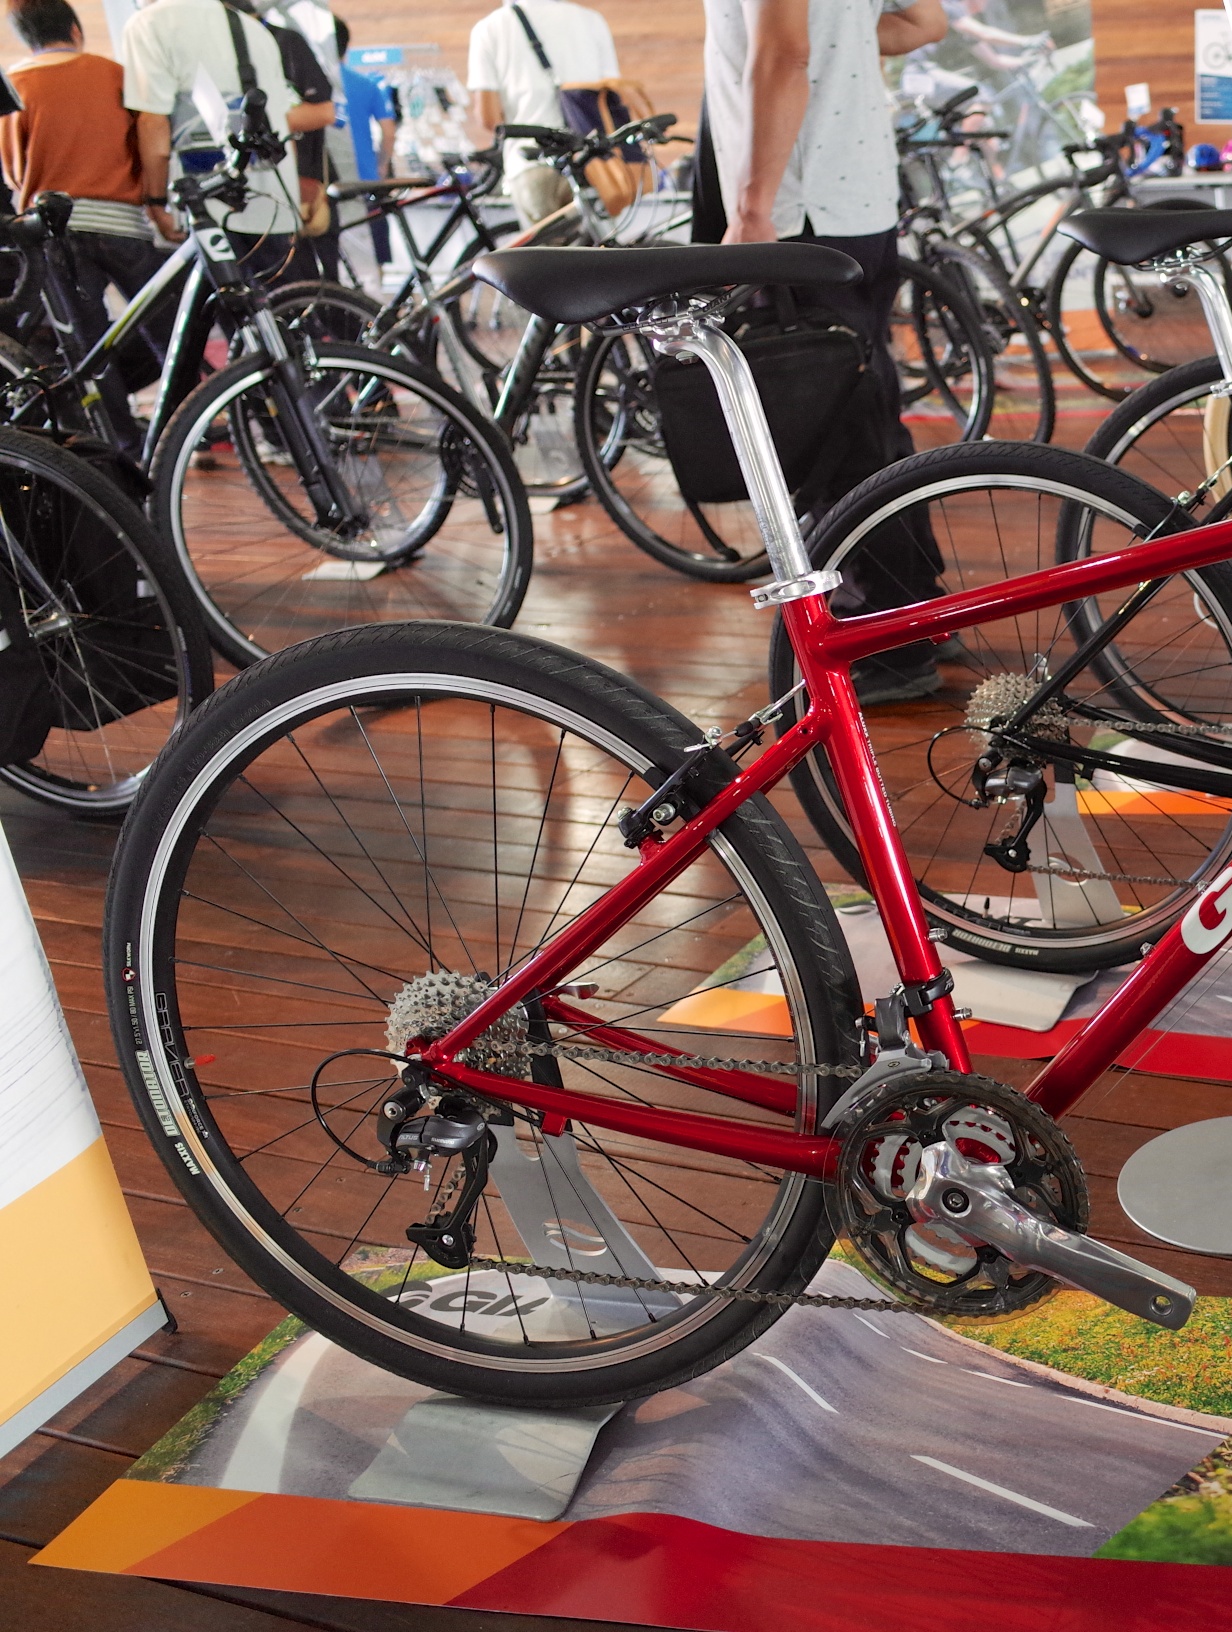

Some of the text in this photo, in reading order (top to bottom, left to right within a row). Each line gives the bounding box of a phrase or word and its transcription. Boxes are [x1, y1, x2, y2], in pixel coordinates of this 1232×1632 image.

[858, 711, 897, 827] ALUXX TRIPLE BUTTED TUBING
[952, 928, 1012, 953] DETONATOR
[128, 994, 136, 1007] MAX
[156, 992, 189, 1097] GRAVIER
[135, 1049, 180, 1137] DETONATOR
[430, 1136, 455, 1145] SHIMANO
[174, 1142, 201, 1176] MAXXIS
